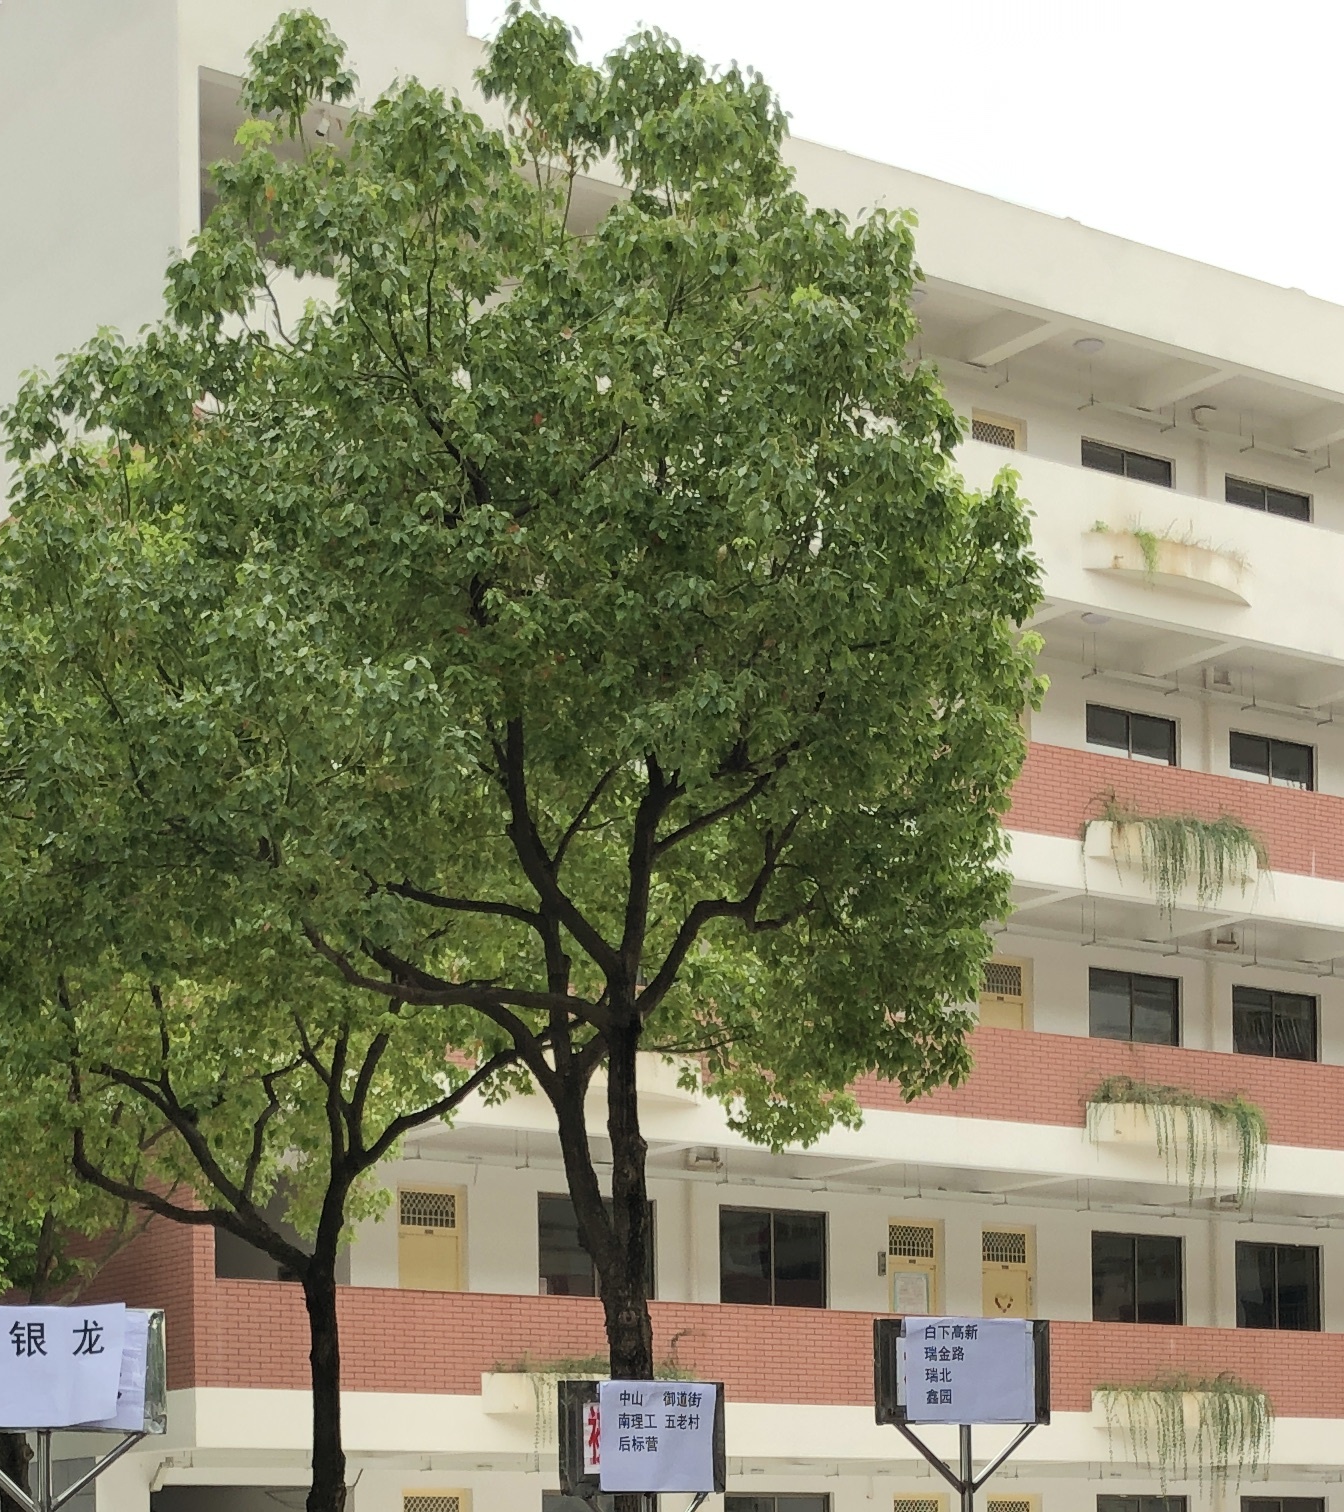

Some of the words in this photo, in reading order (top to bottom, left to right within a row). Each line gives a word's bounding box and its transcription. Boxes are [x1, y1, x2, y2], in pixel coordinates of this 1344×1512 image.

[8, 1319, 105, 1357] 银龙
[924, 1324, 978, 1341] 白下高新
[924, 1346, 965, 1362] 瑞金路
[924, 1367, 952, 1383] 瑞北
[619, 1389, 643, 1407] 中山
[662, 1391, 702, 1408] 御道街
[926, 1389, 952, 1405] 鑫园
[618, 1413, 657, 1430] 南理工
[664, 1414, 700, 1430] 五老村
[618, 1436, 659, 1452] 后标营
